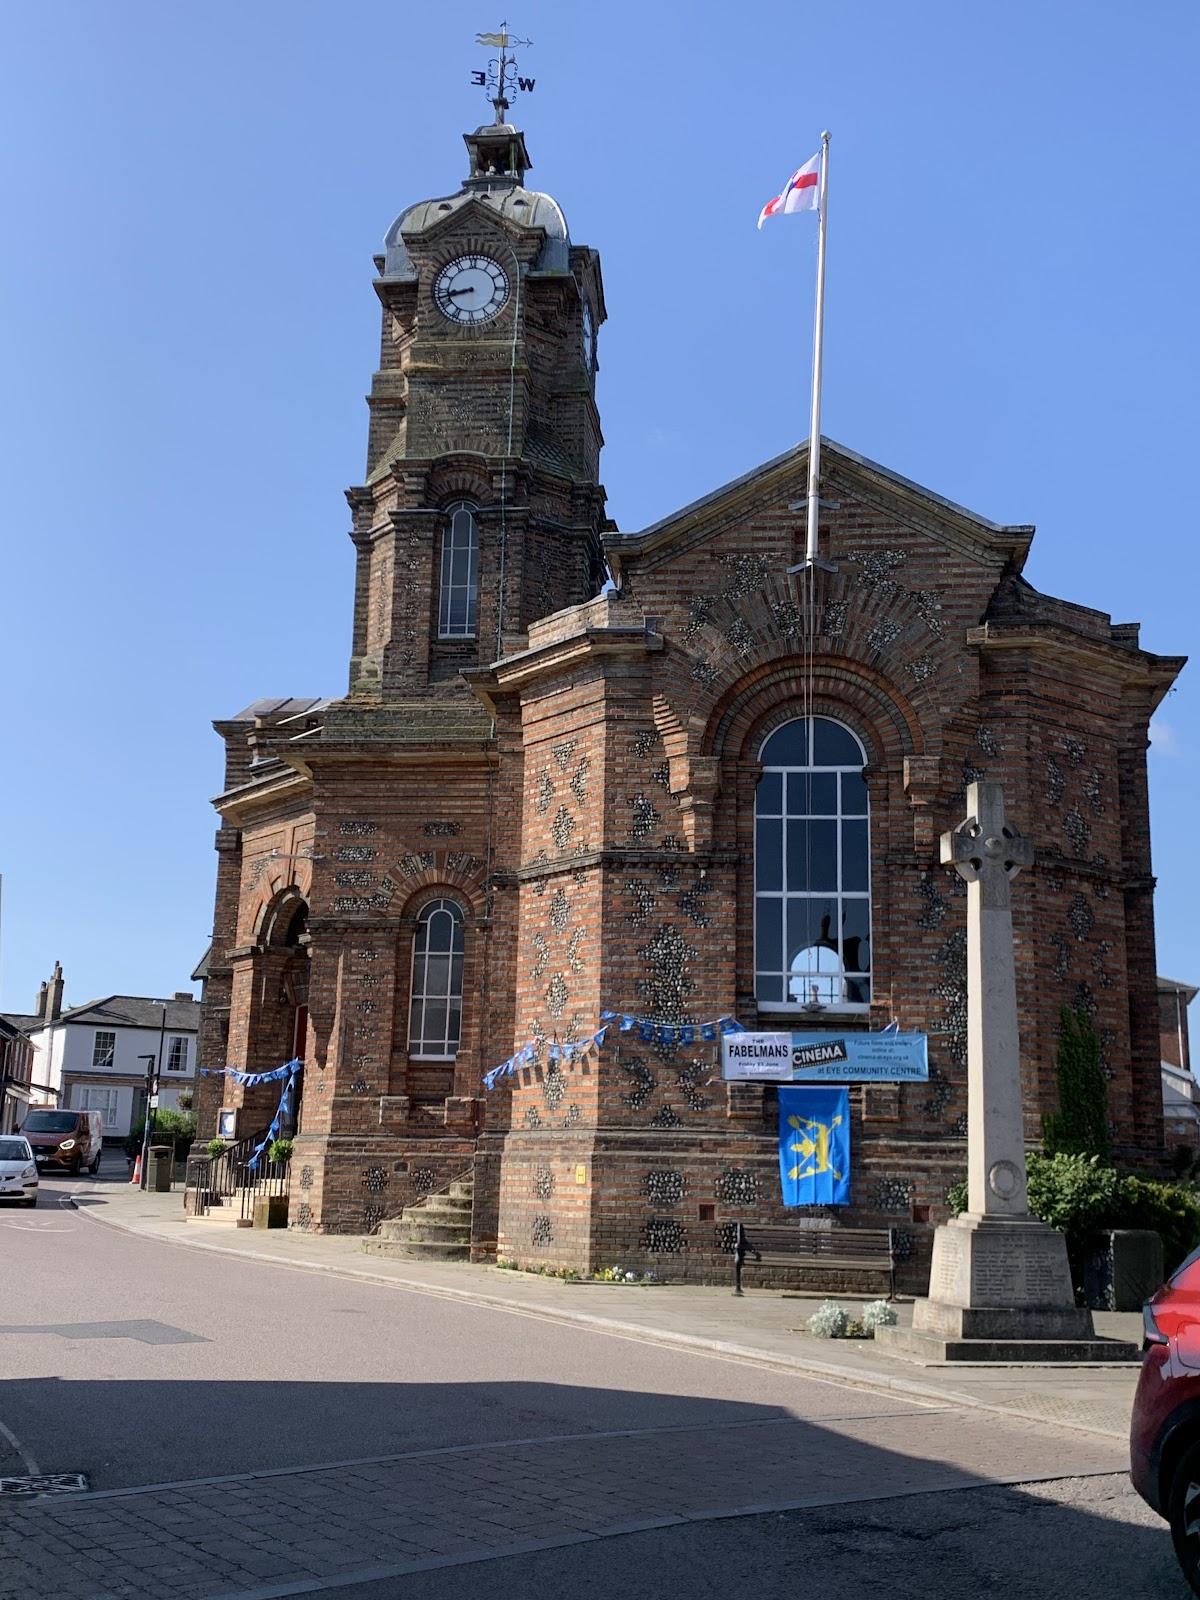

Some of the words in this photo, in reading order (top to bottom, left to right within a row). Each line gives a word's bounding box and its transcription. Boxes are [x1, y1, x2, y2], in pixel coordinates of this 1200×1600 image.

[518, 77, 536, 92] W
[729, 1045, 789, 1058] FABELMANS
[793, 1045, 843, 1064] CINEMA
[826, 1067, 841, 1075] EYE
[842, 1066, 889, 1075] COMMUNITY
[890, 1067, 921, 1075] CENTRE
